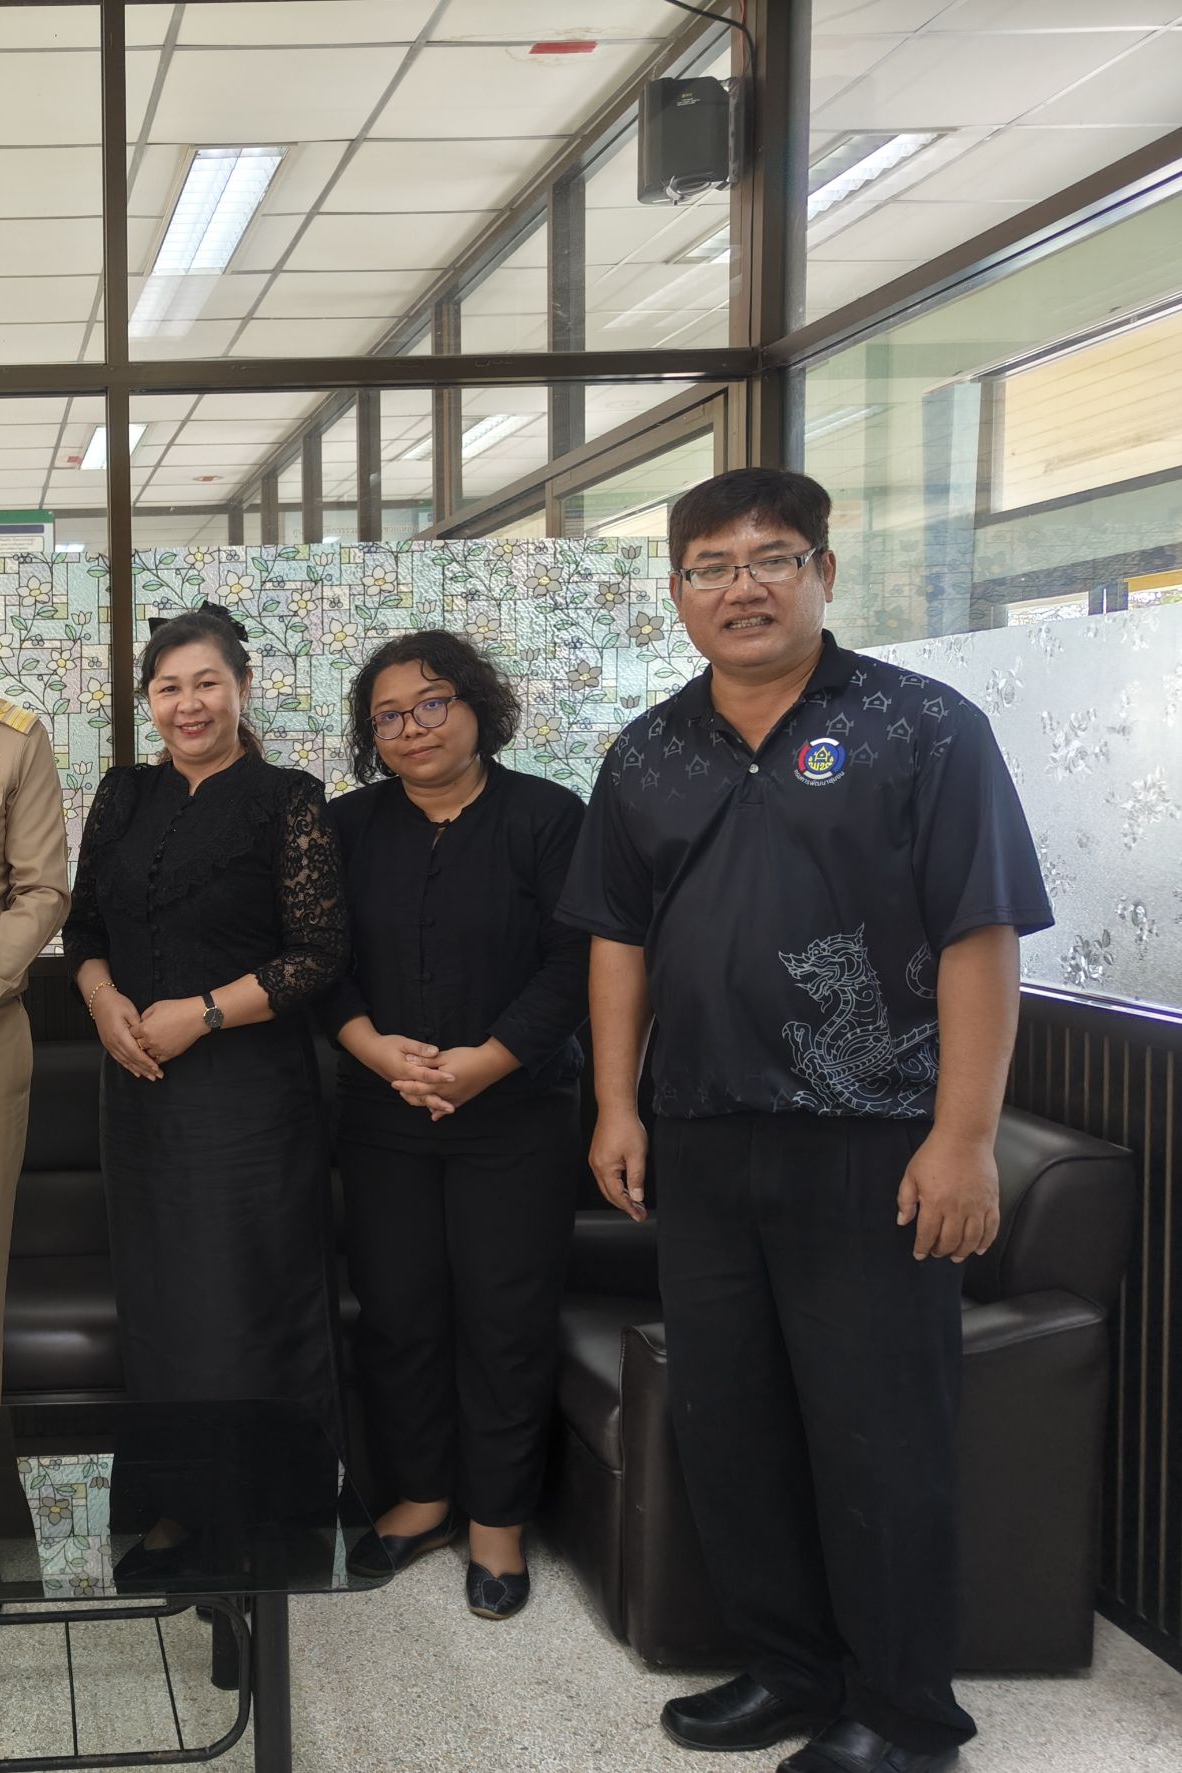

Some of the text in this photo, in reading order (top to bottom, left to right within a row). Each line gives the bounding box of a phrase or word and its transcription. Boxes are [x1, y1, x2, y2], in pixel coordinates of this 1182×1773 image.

[794, 769, 845, 786] กรมการพัฒนาชุมชน
